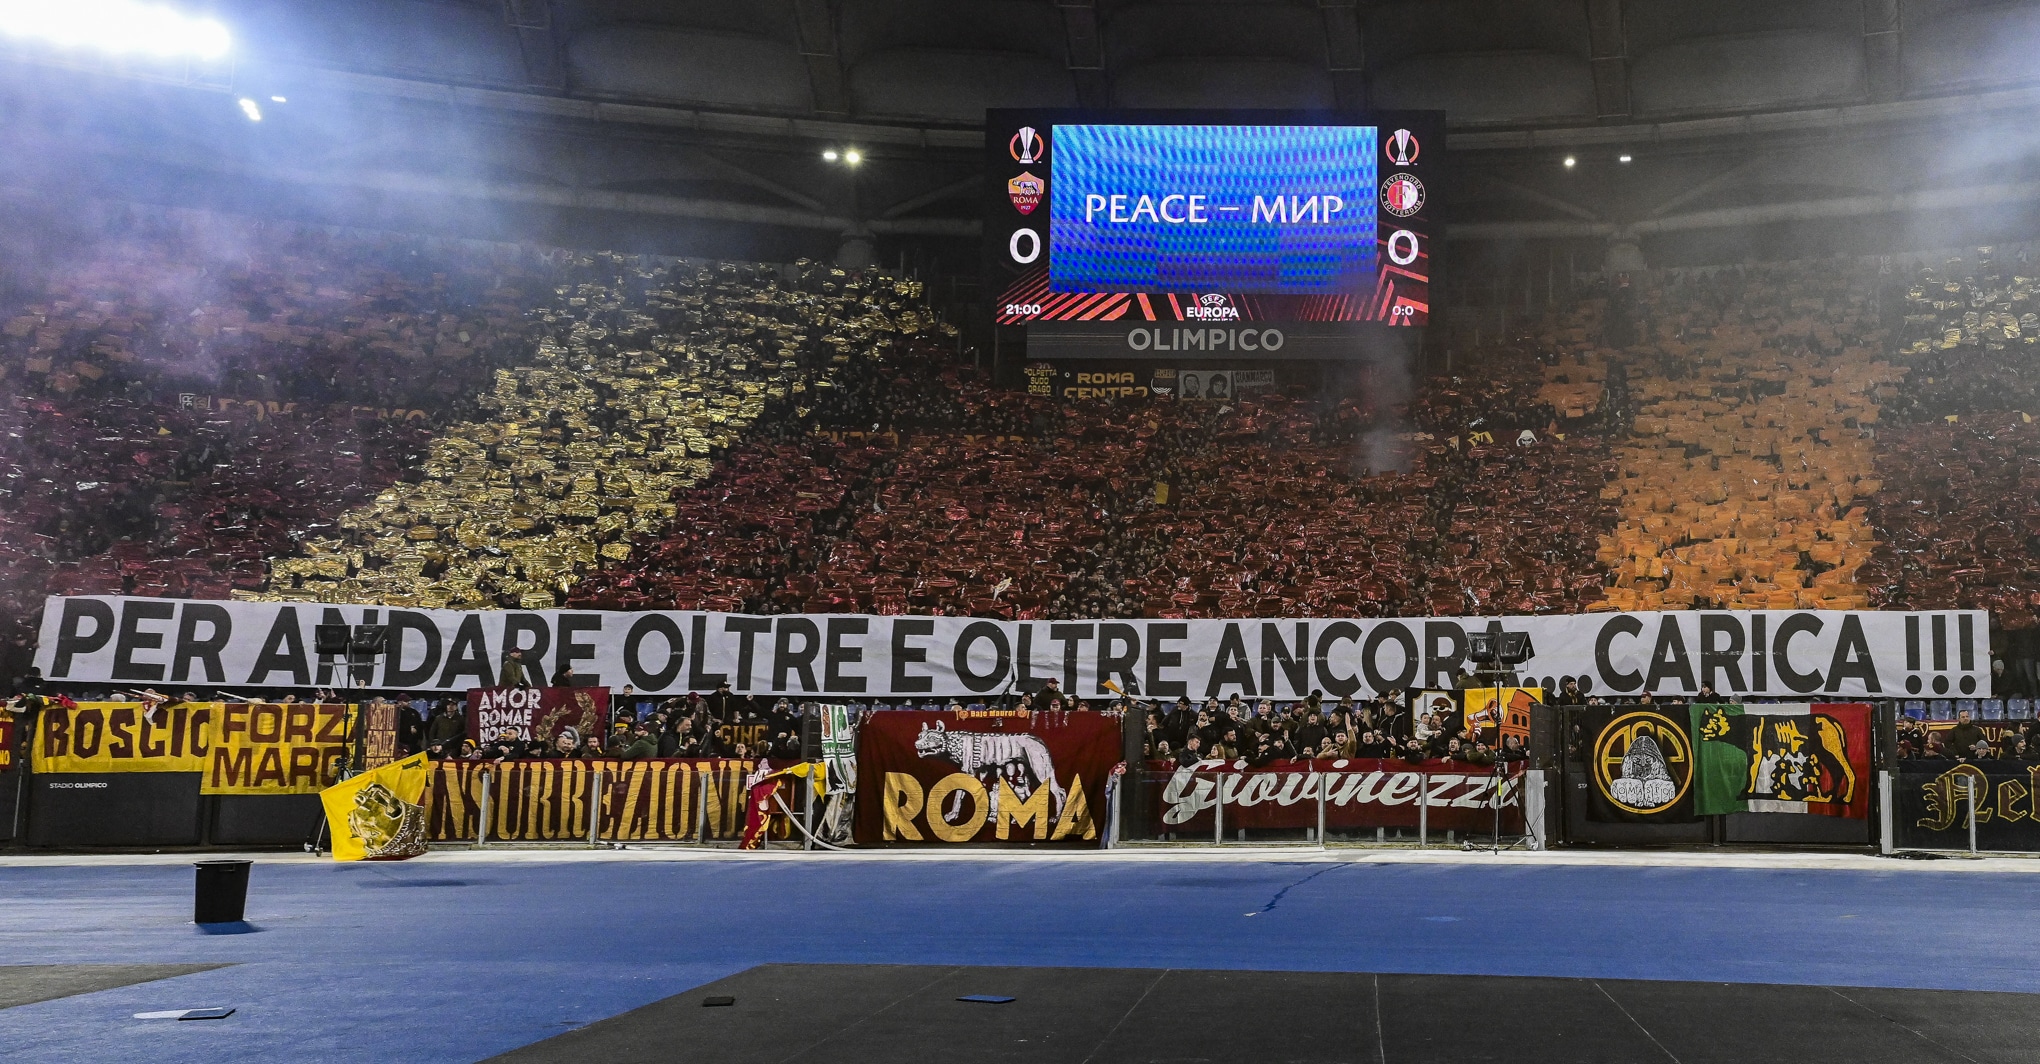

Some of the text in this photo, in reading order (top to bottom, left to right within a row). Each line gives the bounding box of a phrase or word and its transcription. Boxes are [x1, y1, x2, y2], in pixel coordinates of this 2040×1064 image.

[1384, 175, 1421, 191] FEYENOORD
[1013, 196, 1039, 204] ROMA
[1085, 194, 1208, 223] PEACE
[1251, 195, 1343, 223] МИР
[1383, 199, 1421, 216] ROTTERDAM
[1009, 228, 1041, 264] 0
[1387, 229, 1419, 265] 0
[1201, 295, 1225, 305] UEFA
[1005, 303, 1041, 315] 21:00
[1186, 306, 1240, 318] EUROPA
[1392, 305, 1414, 316] 0:0
[1127, 327, 1284, 351] OLIMPICO
[1077, 372, 1135, 384] ROMA
[51, 597, 232, 682] PER
[247, 606, 602, 689] ANDARE
[623, 613, 869, 693] OLTRE
[890, 618, 935, 692] E
[953, 620, 1188, 697] OLTRE
[1904, 613, 1977, 695] !!!
[478, 688, 541, 710] AMOR
[479, 709, 532, 727] ROMAE
[480, 726, 532, 742] NOSRA
[1163, 760, 1519, 825] Giovinezza
[883, 772, 1097, 842] ROMA
